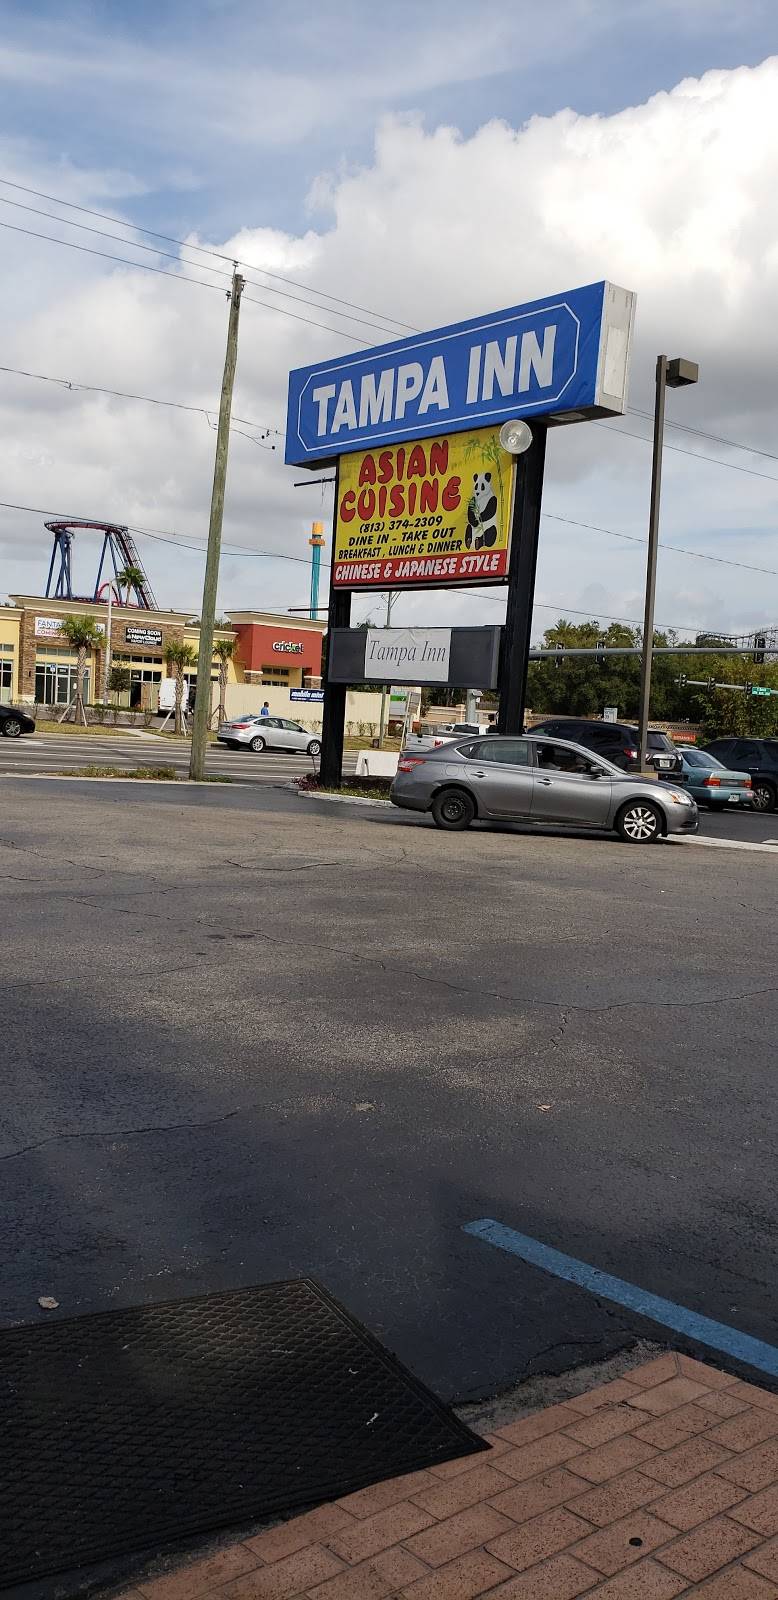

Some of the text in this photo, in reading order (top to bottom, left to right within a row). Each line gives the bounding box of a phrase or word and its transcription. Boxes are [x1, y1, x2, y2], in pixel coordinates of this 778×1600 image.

[312, 325, 557, 437] TAMPA INN
[358, 440, 448, 487] ASIAN
[340, 476, 462, 522] CUISINE
[349, 535, 373, 546] DINE
[376, 534, 388, 544] IN
[402, 530, 428, 542] TAKE
[432, 527, 456, 540] OUT
[360, 516, 443, 533] (813) 374-2309
[389, 544, 415, 556] LUNCH
[418, 544, 424, 553] &
[427, 540, 462, 553] DINNER
[335, 554, 500, 581] CHINESE & JAPANESE STYLE
[272, 640, 304, 654] cricket
[369, 640, 446, 666] Tampa Inn
